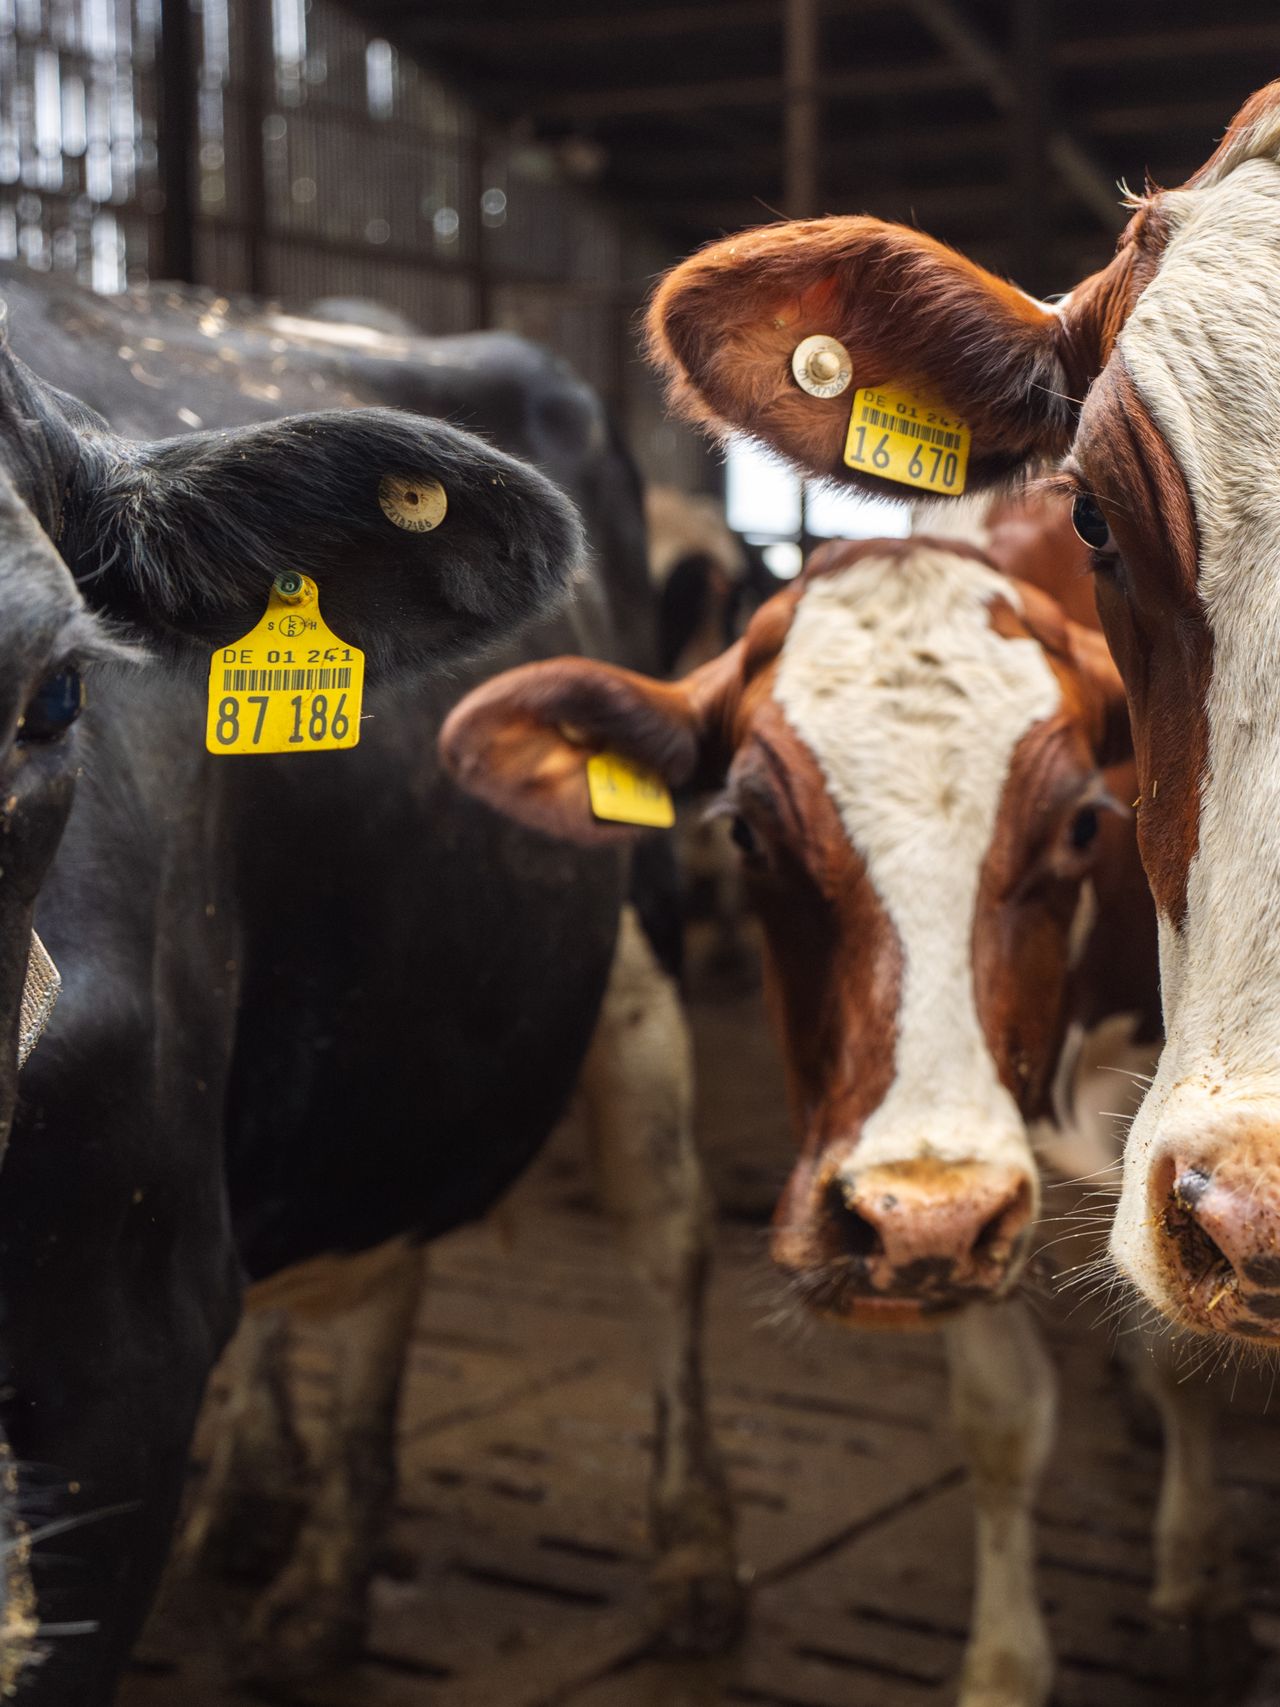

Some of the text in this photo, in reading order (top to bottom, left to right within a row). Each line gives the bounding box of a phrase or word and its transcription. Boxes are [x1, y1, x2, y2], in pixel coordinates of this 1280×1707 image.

[864, 390, 887, 407] DE
[896, 402, 918, 419] 01
[850, 426, 958, 487] 16 670
[223, 649, 253, 664] DE
[267, 650, 296, 664] 01
[216, 693, 350, 746] 87 186
